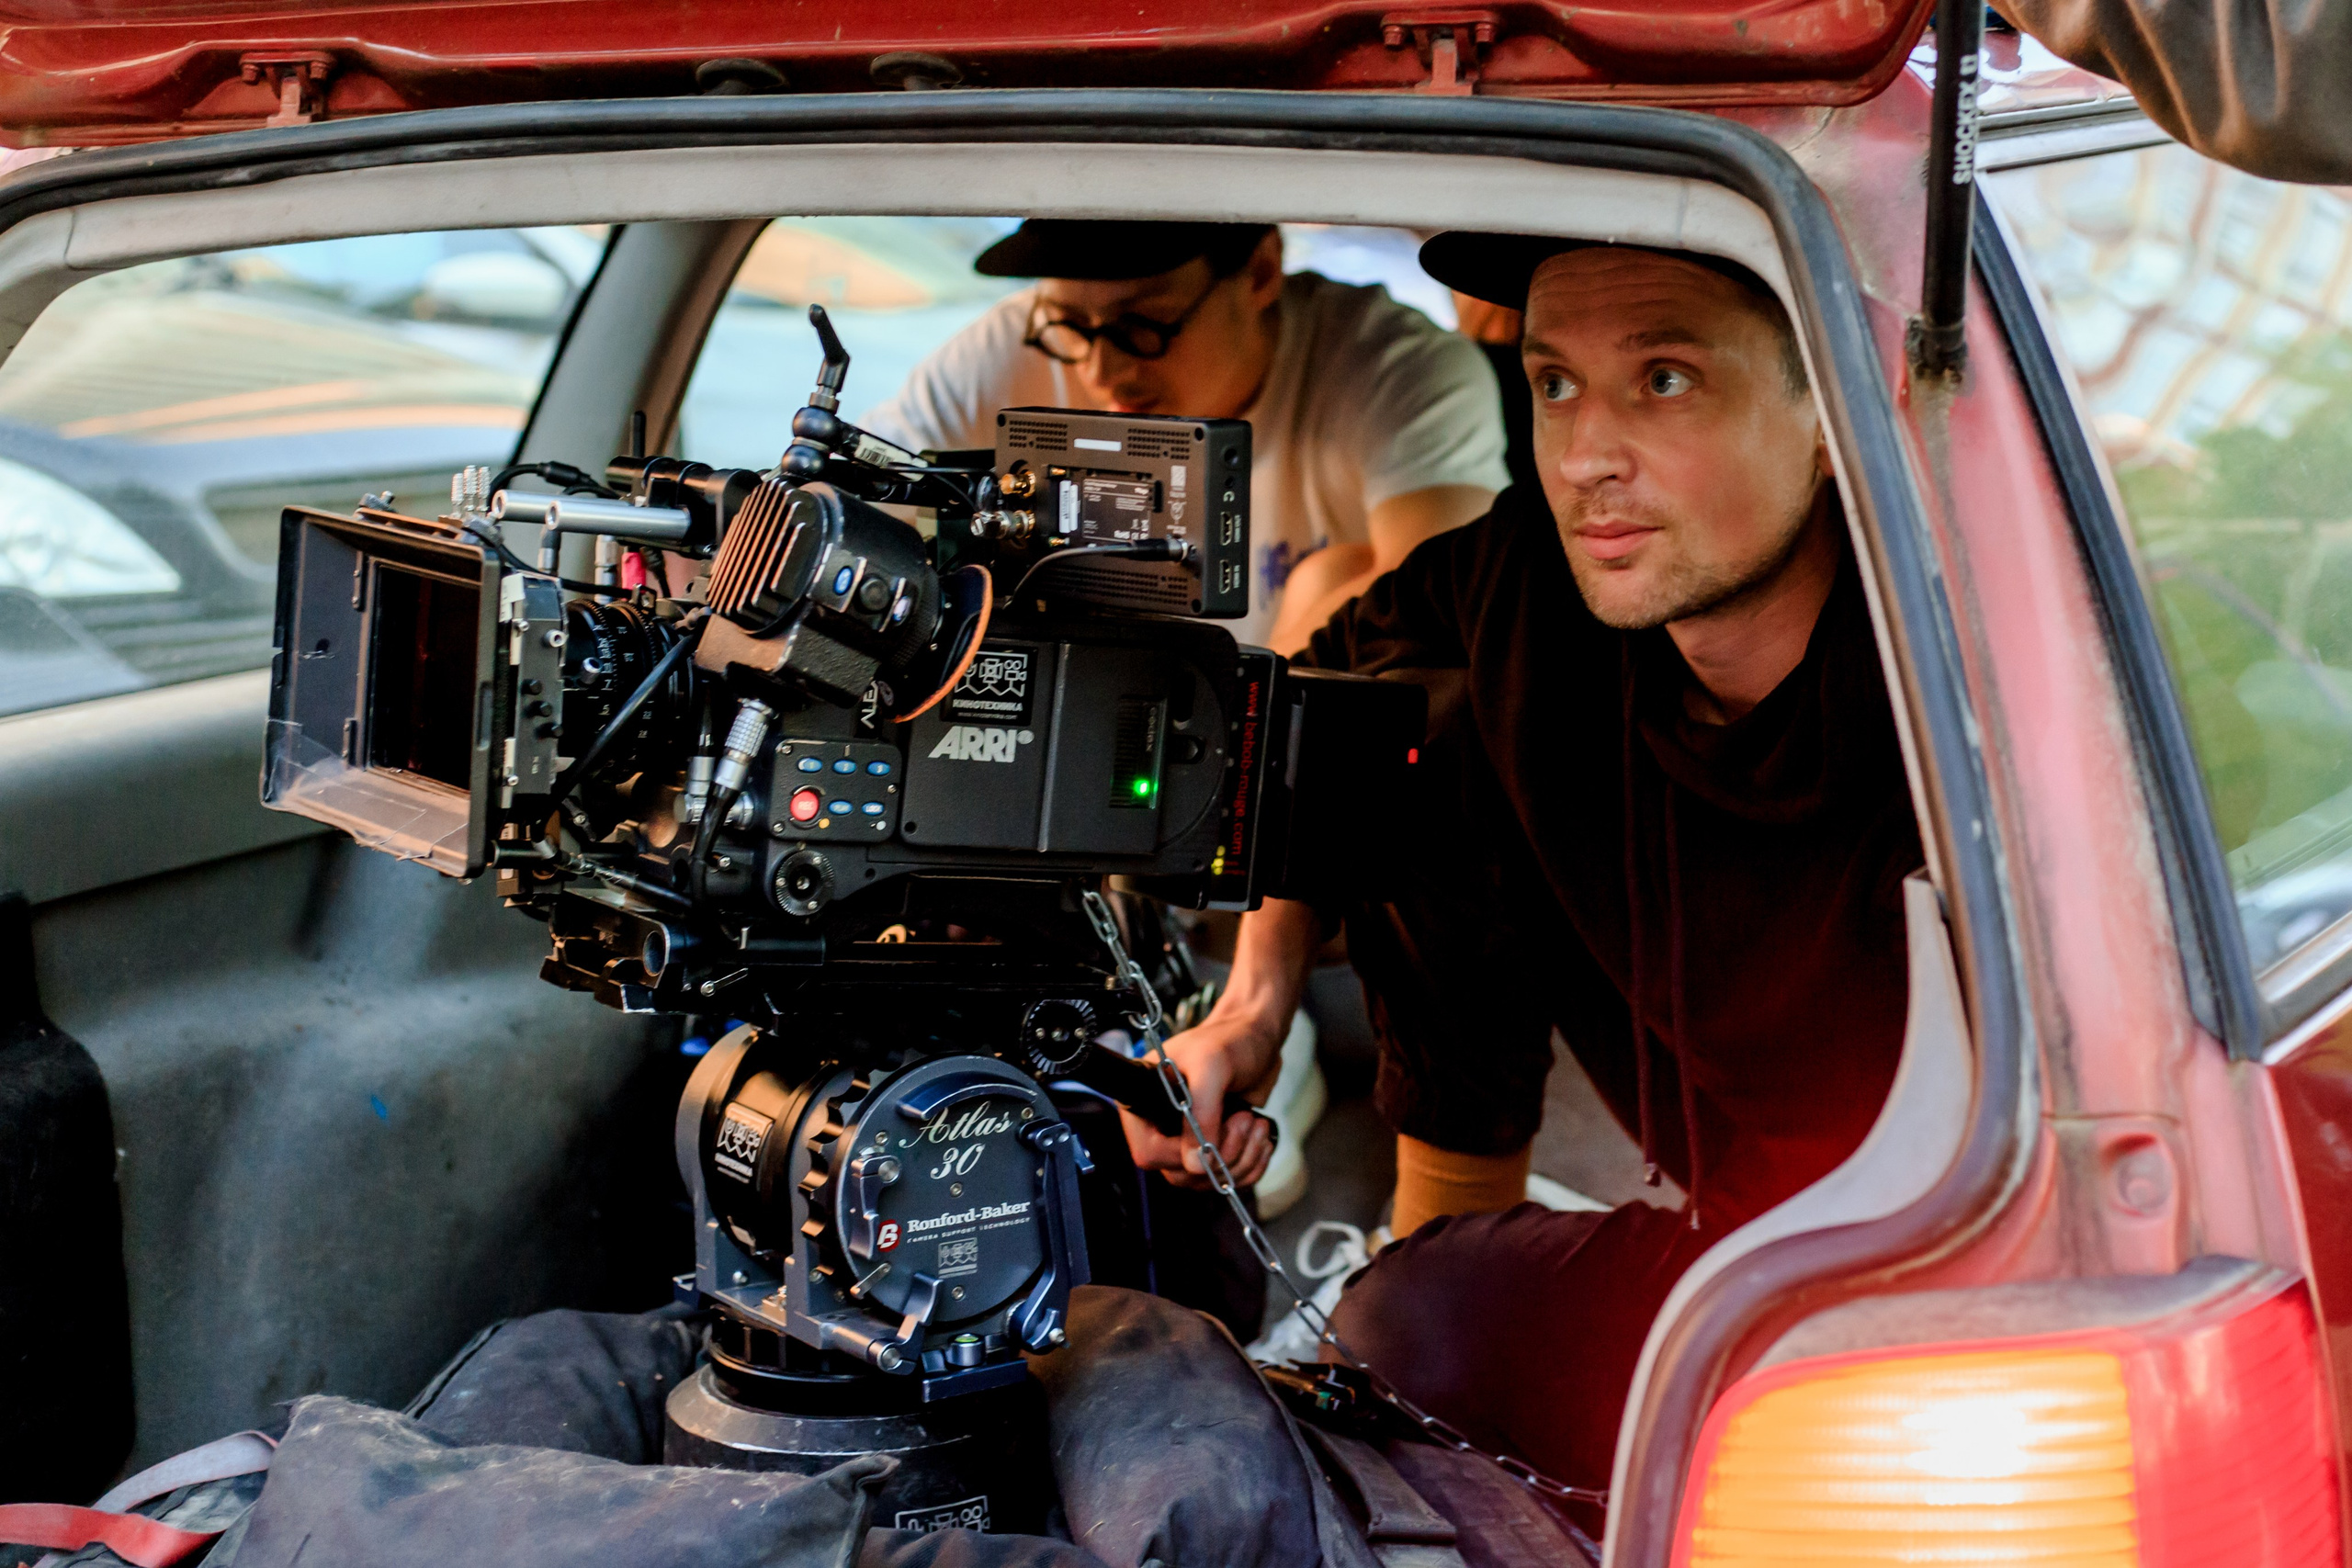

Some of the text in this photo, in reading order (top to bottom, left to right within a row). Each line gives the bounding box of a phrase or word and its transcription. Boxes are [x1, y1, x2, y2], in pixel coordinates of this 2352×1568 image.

[860, 680, 879, 729] ALE
[927, 725, 1017, 763] ARRI
[797, 800, 816, 811] REC
[898, 1100, 1014, 1149] Atlas
[930, 1143, 987, 1180] 30
[906, 1201, 1031, 1234] Ronford-Baker
[941, 1226, 977, 1238] SUPPORT
